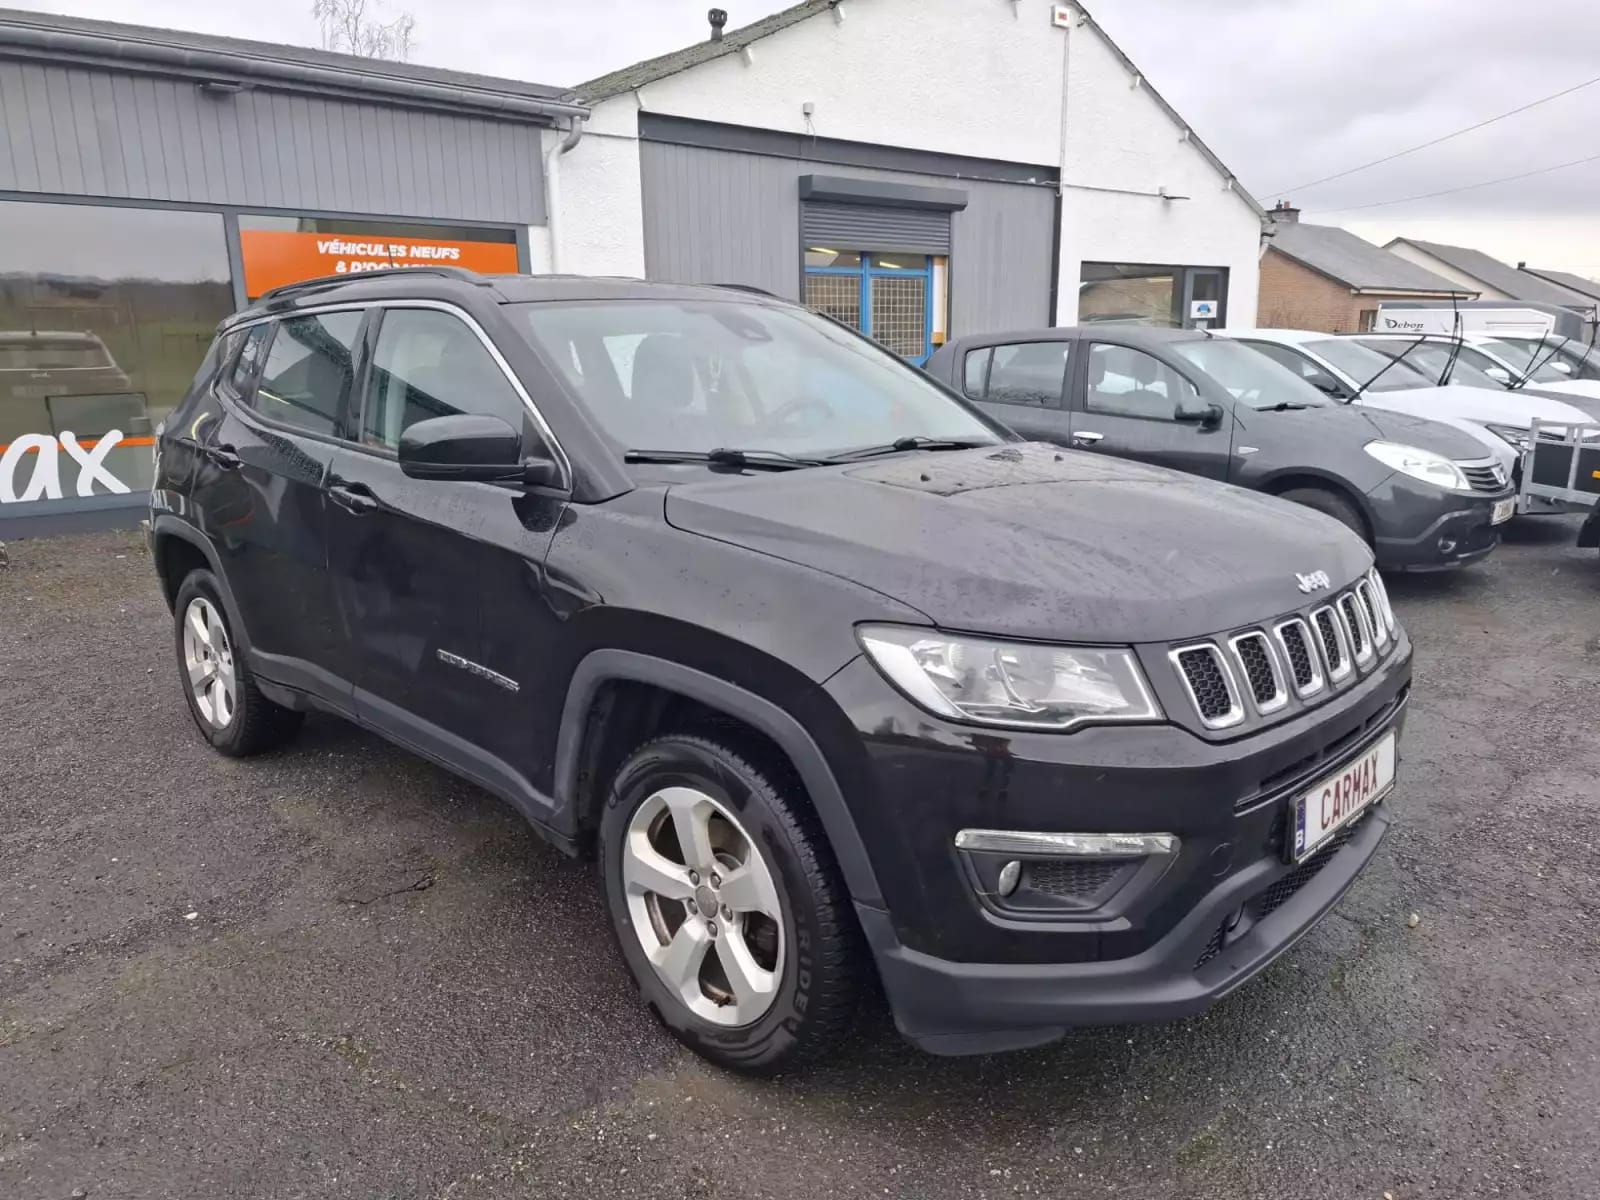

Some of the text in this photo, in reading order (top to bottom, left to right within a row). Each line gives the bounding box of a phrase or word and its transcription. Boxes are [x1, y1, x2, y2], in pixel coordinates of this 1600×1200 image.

[317, 239, 460, 260] VÉHICULES NEUFS
[335, 260, 347, 273] &
[1384, 317, 1425, 329] Debon
[1321, 750, 1378, 830] CARMAX
